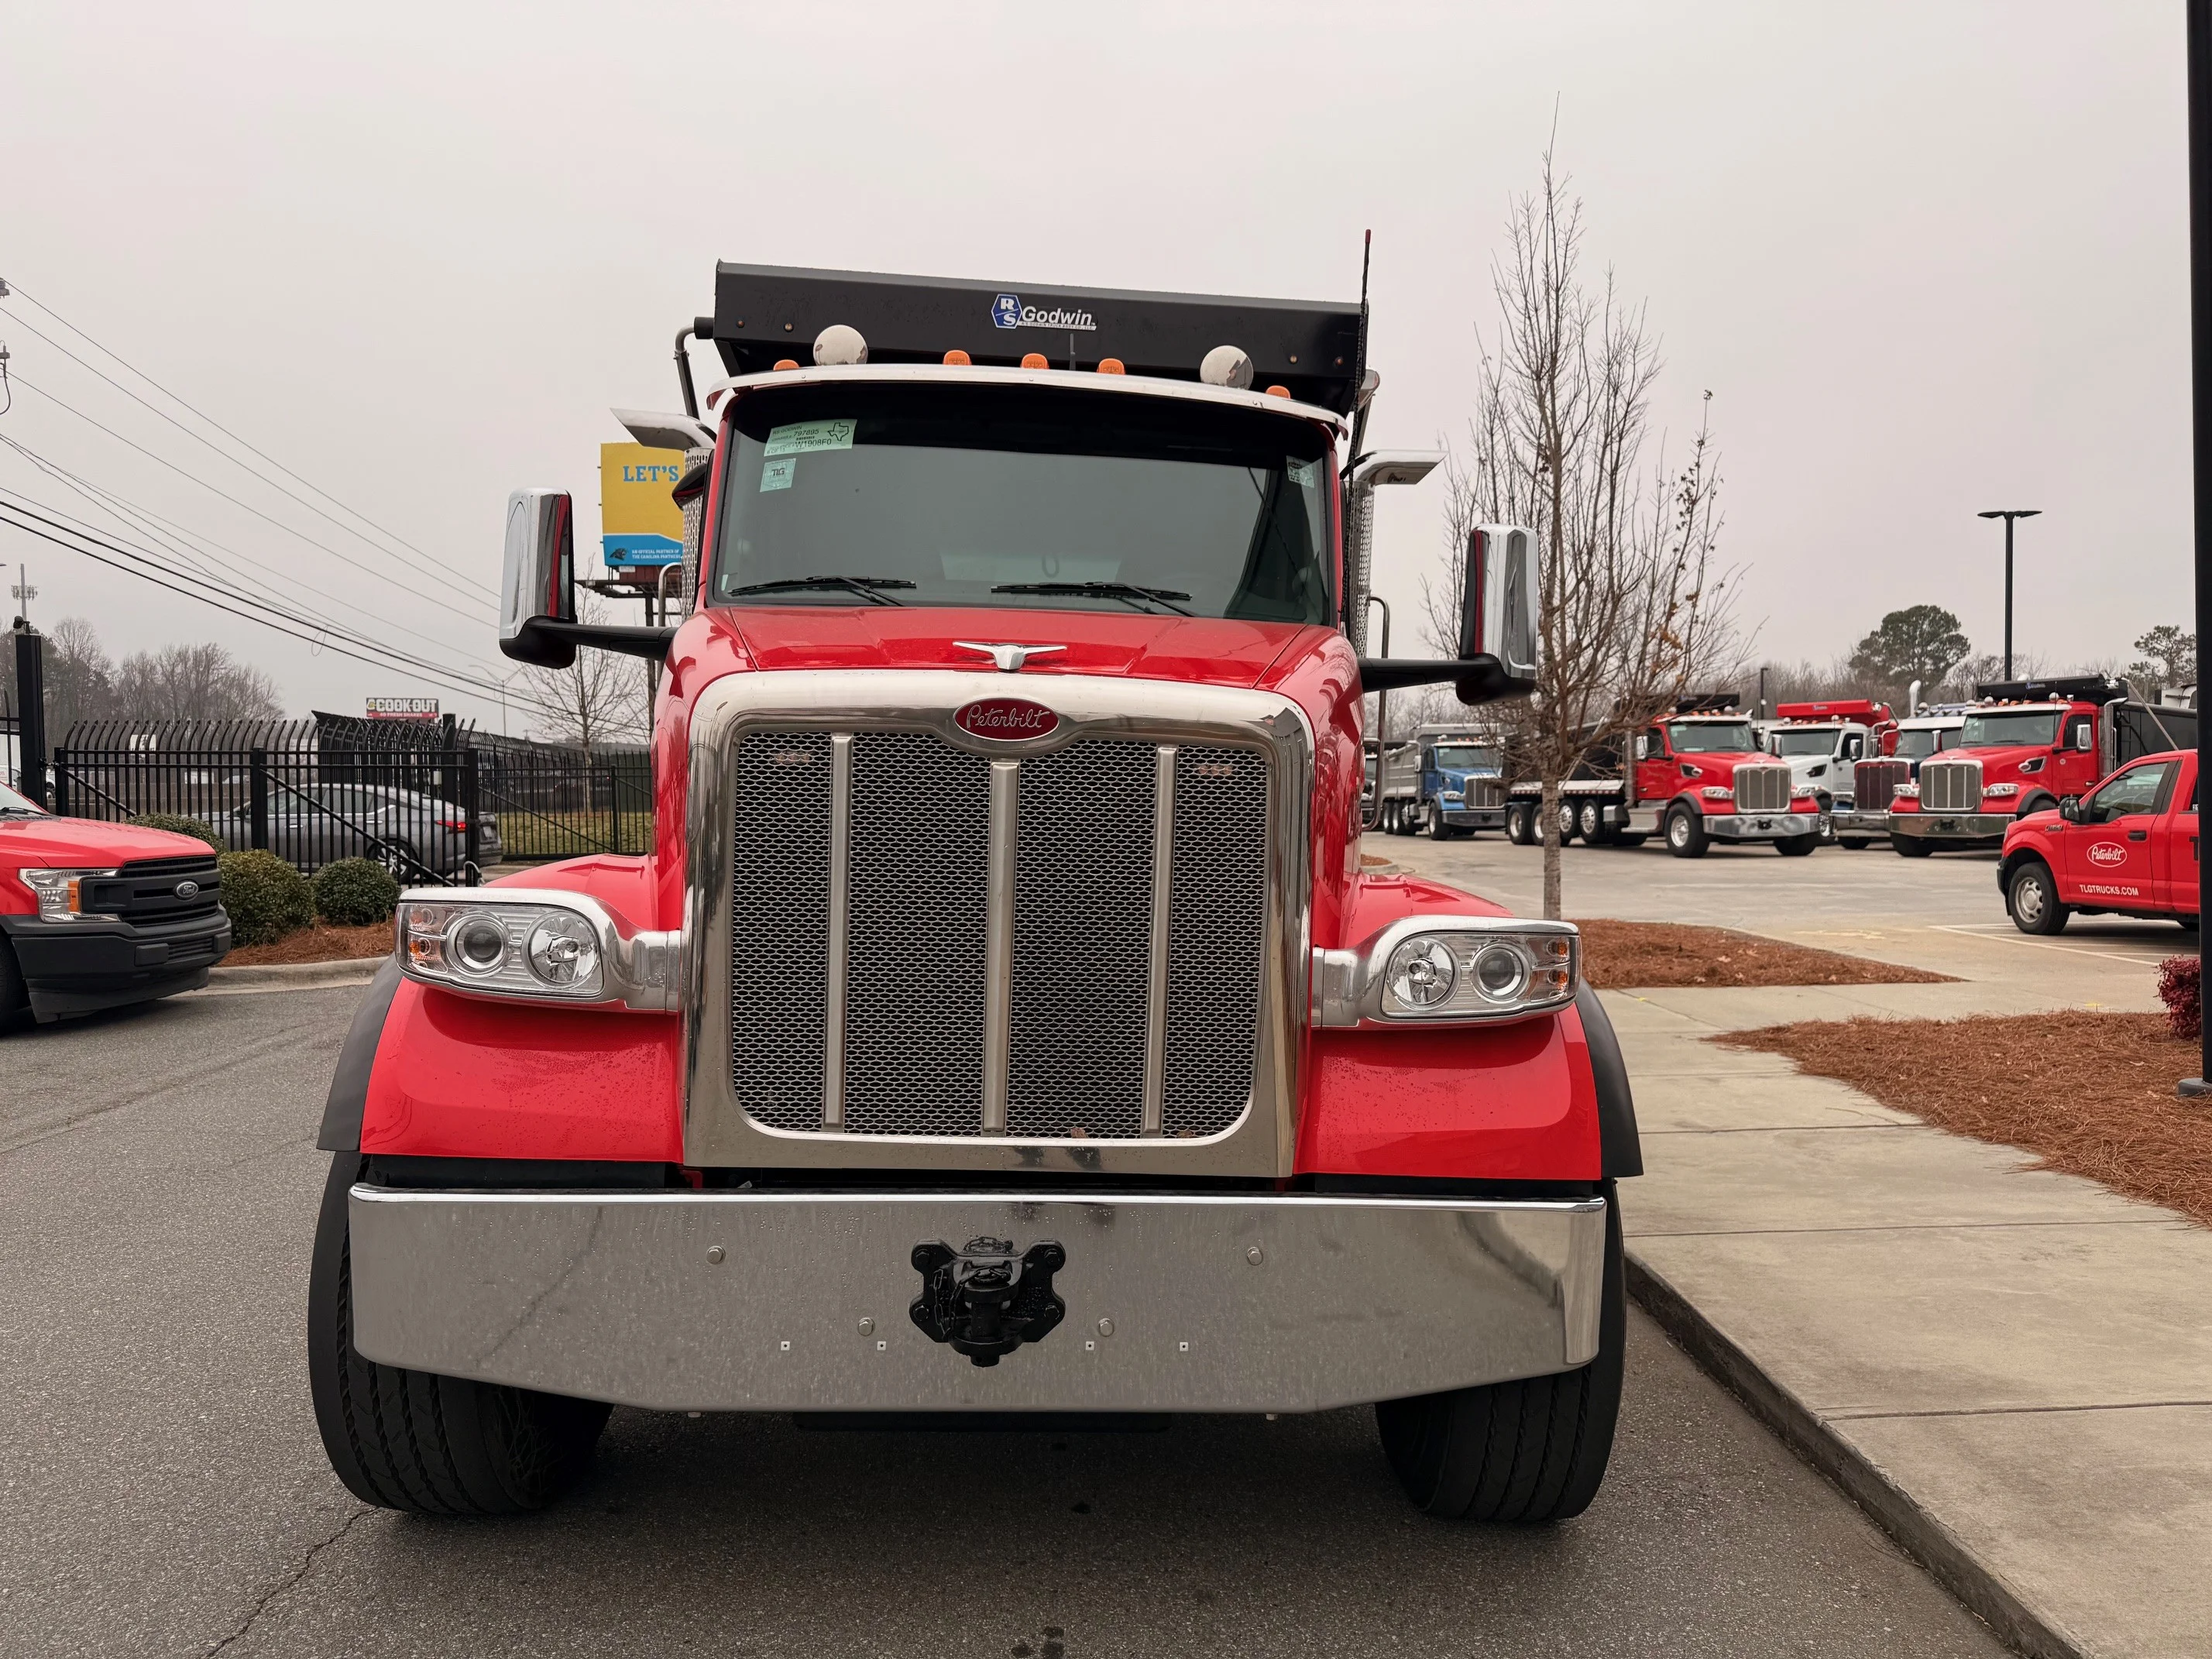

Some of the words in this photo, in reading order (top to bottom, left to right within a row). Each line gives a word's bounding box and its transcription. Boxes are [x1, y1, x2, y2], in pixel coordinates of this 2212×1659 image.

[1000, 298, 1015, 310] R
[1003, 313, 1016, 325] S
[1022, 305, 1093, 326] Godwin
[795, 438, 832, 448] W1908F0
[966, 704, 1050, 729] Peterbilt
[2091, 846, 2124, 861] Peterbilt
[2079, 884, 2139, 896] TLGTRUCKS.COM
